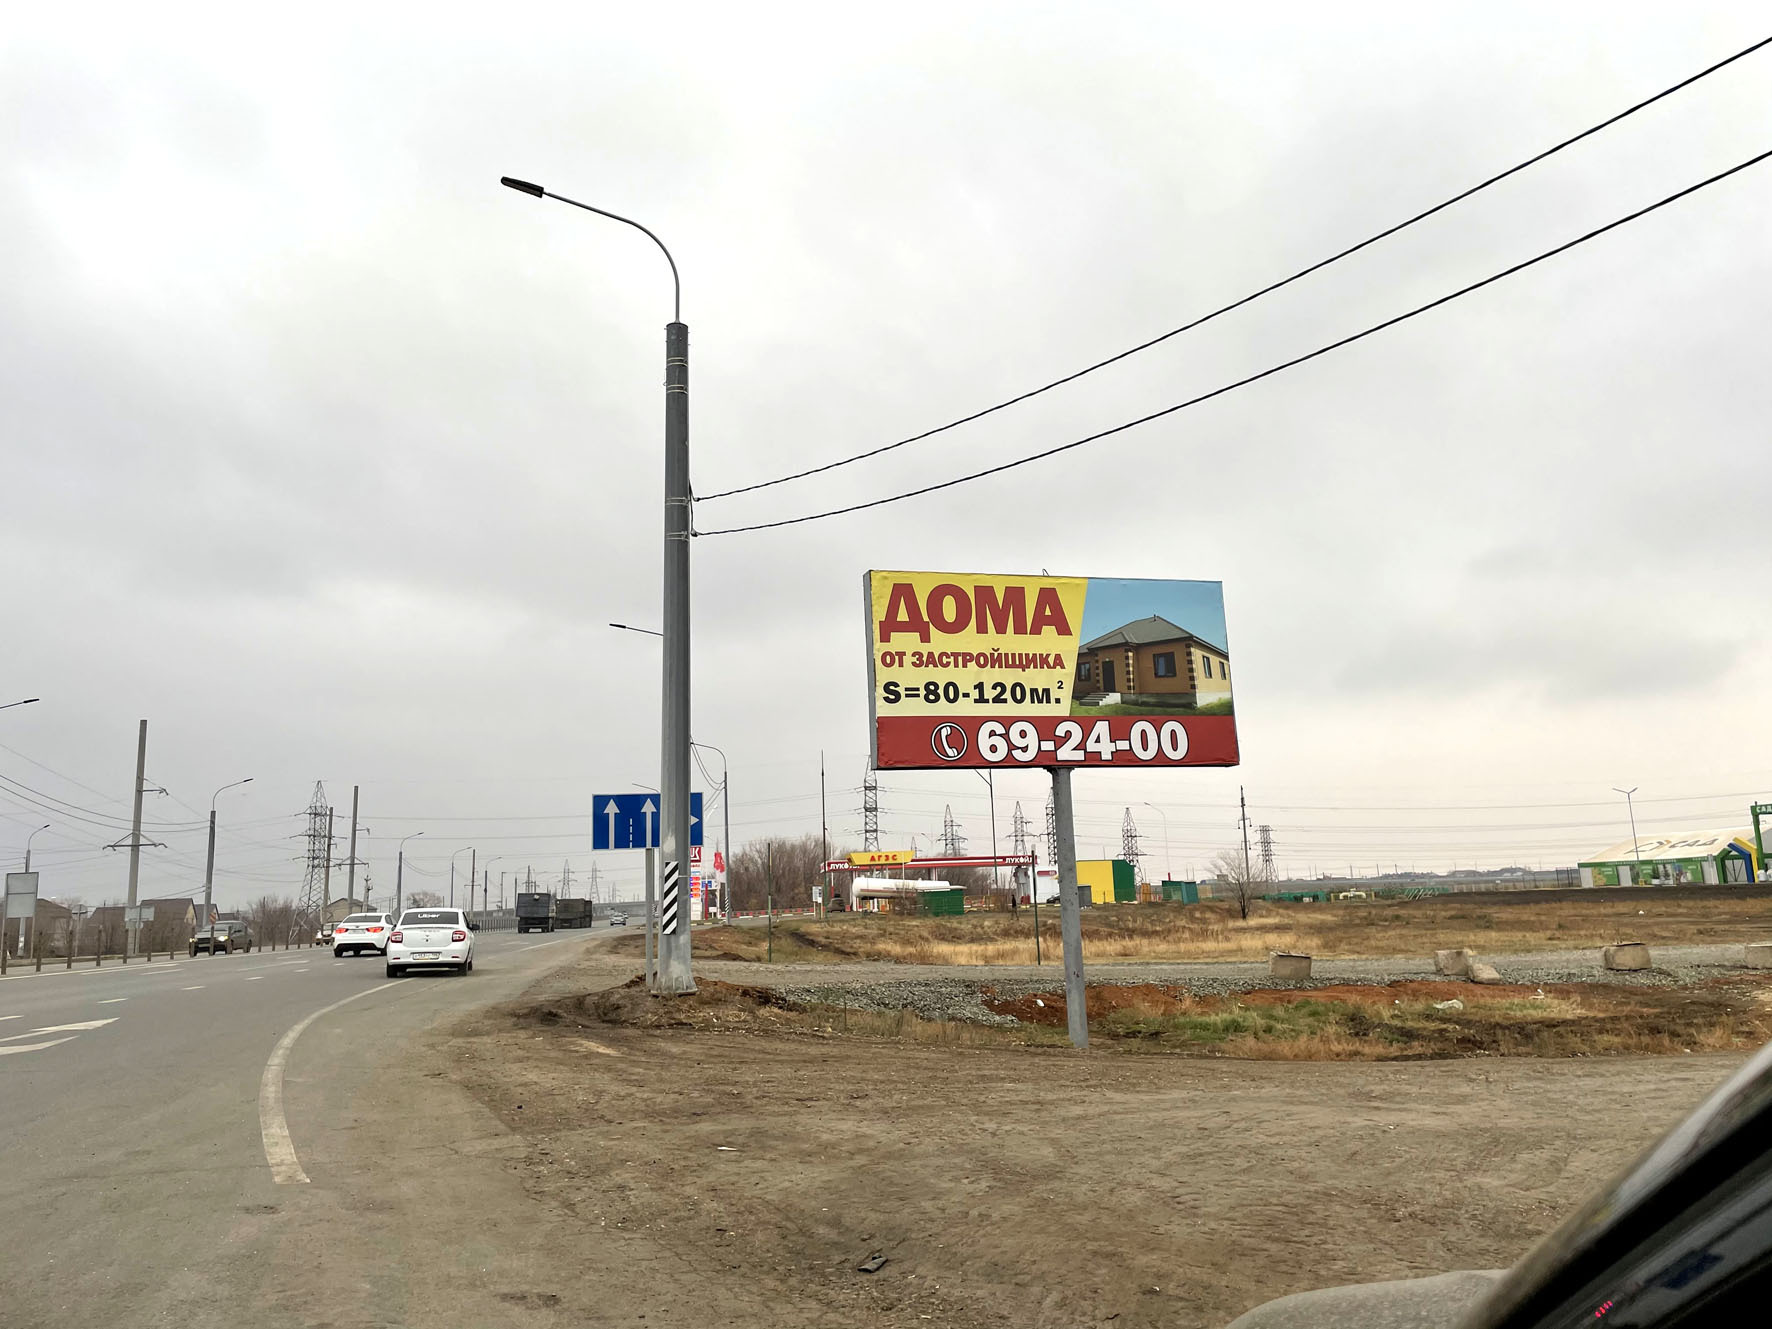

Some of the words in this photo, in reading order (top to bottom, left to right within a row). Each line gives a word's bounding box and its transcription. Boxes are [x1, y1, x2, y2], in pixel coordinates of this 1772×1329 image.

[880, 583, 1072, 643] ДОМА
[881, 650, 905, 668] ОТ
[911, 648, 1065, 672] ЗАСТРОЙЩИКА
[977, 720, 1189, 762] 69-24-00
[870, 854, 898, 862] АГЗС
